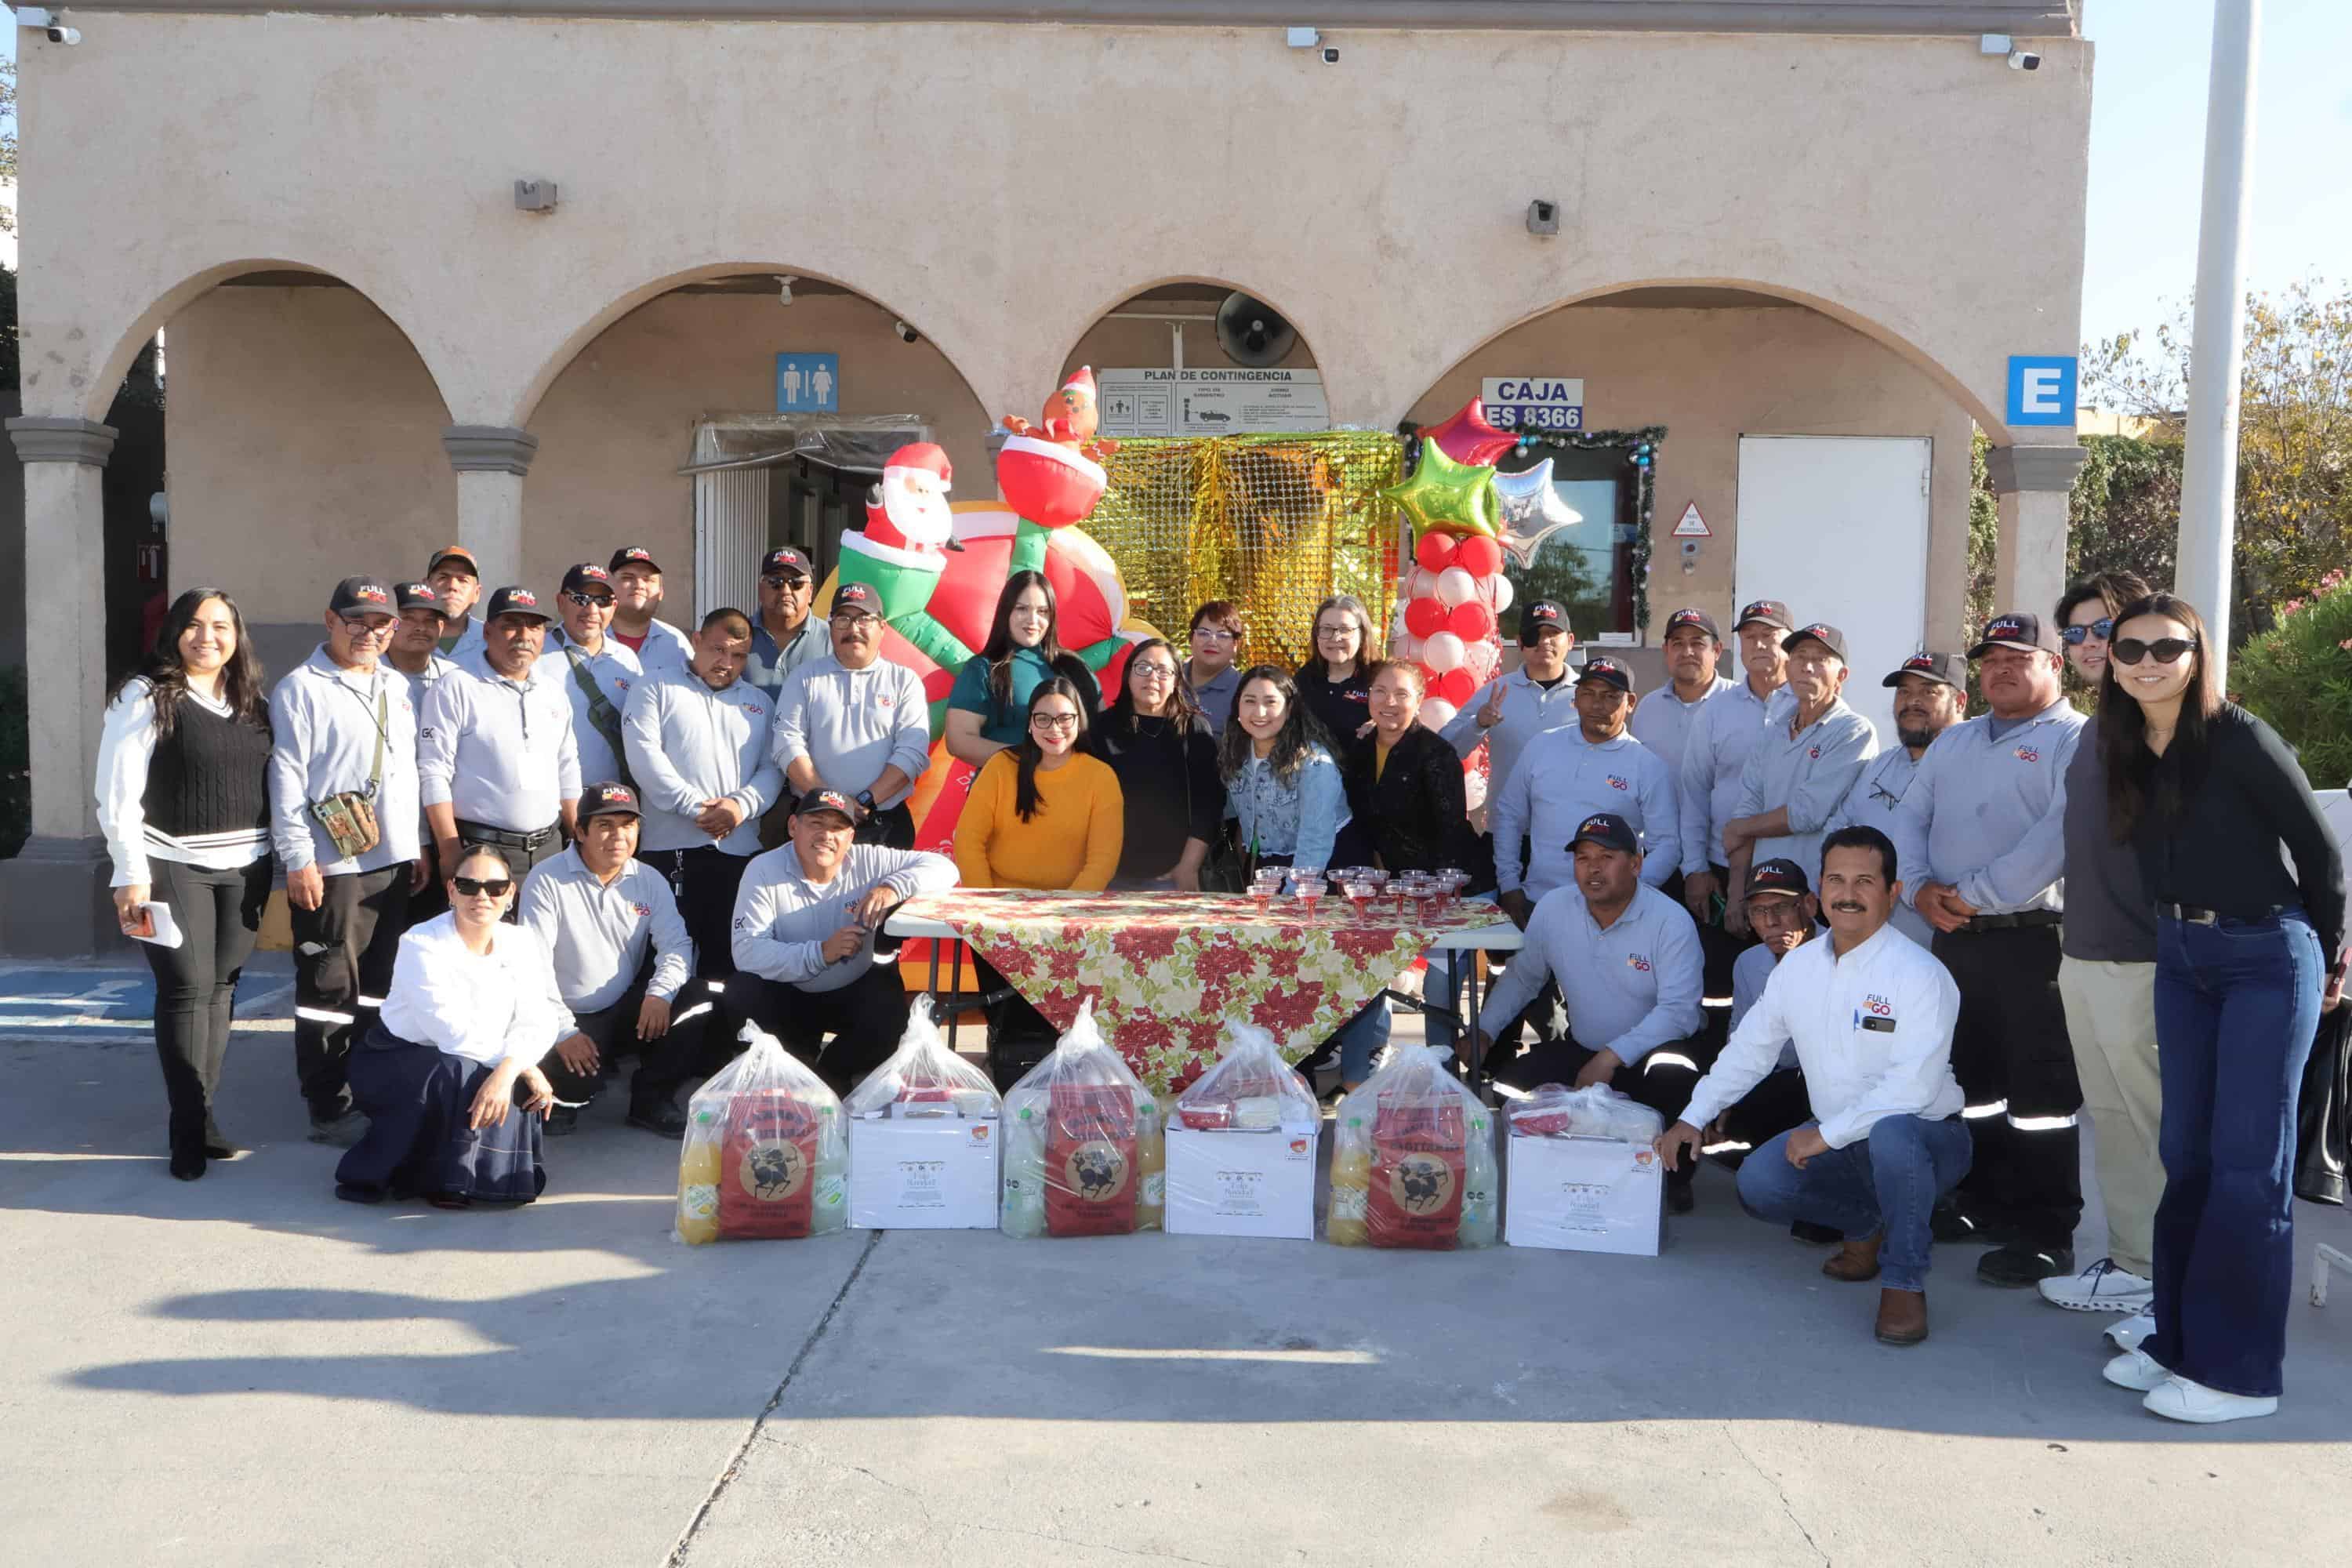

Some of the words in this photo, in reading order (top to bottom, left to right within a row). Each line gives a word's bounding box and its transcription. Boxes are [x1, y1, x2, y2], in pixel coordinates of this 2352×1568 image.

[1145, 371, 1175, 380] PLAN
[1180, 371, 1196, 380] DE
[1200, 371, 1291, 381] CONTINGENCIA
[1497, 382, 1568, 401] CAJA
[2022, 368, 2062, 413] E
[1486, 407, 1516, 426] ES
[1523, 407, 1580, 429] 8366
[360, 585, 387, 596] FULL
[410, 584, 434, 595] FULL
[510, 589, 535, 600] FULL
[2020, 752, 2038, 762] GO
[1606, 774, 1628, 784] FULL
[603, 787, 628, 796] FULL
[1612, 781, 1628, 791] GO
[822, 790, 846, 804] FULL
[636, 907, 652, 916] GO
[1629, 953, 1650, 964] FULL
[1635, 961, 1650, 973] GO
[1866, 993, 1891, 1005] FULL
[1871, 1003, 1891, 1016] GO
